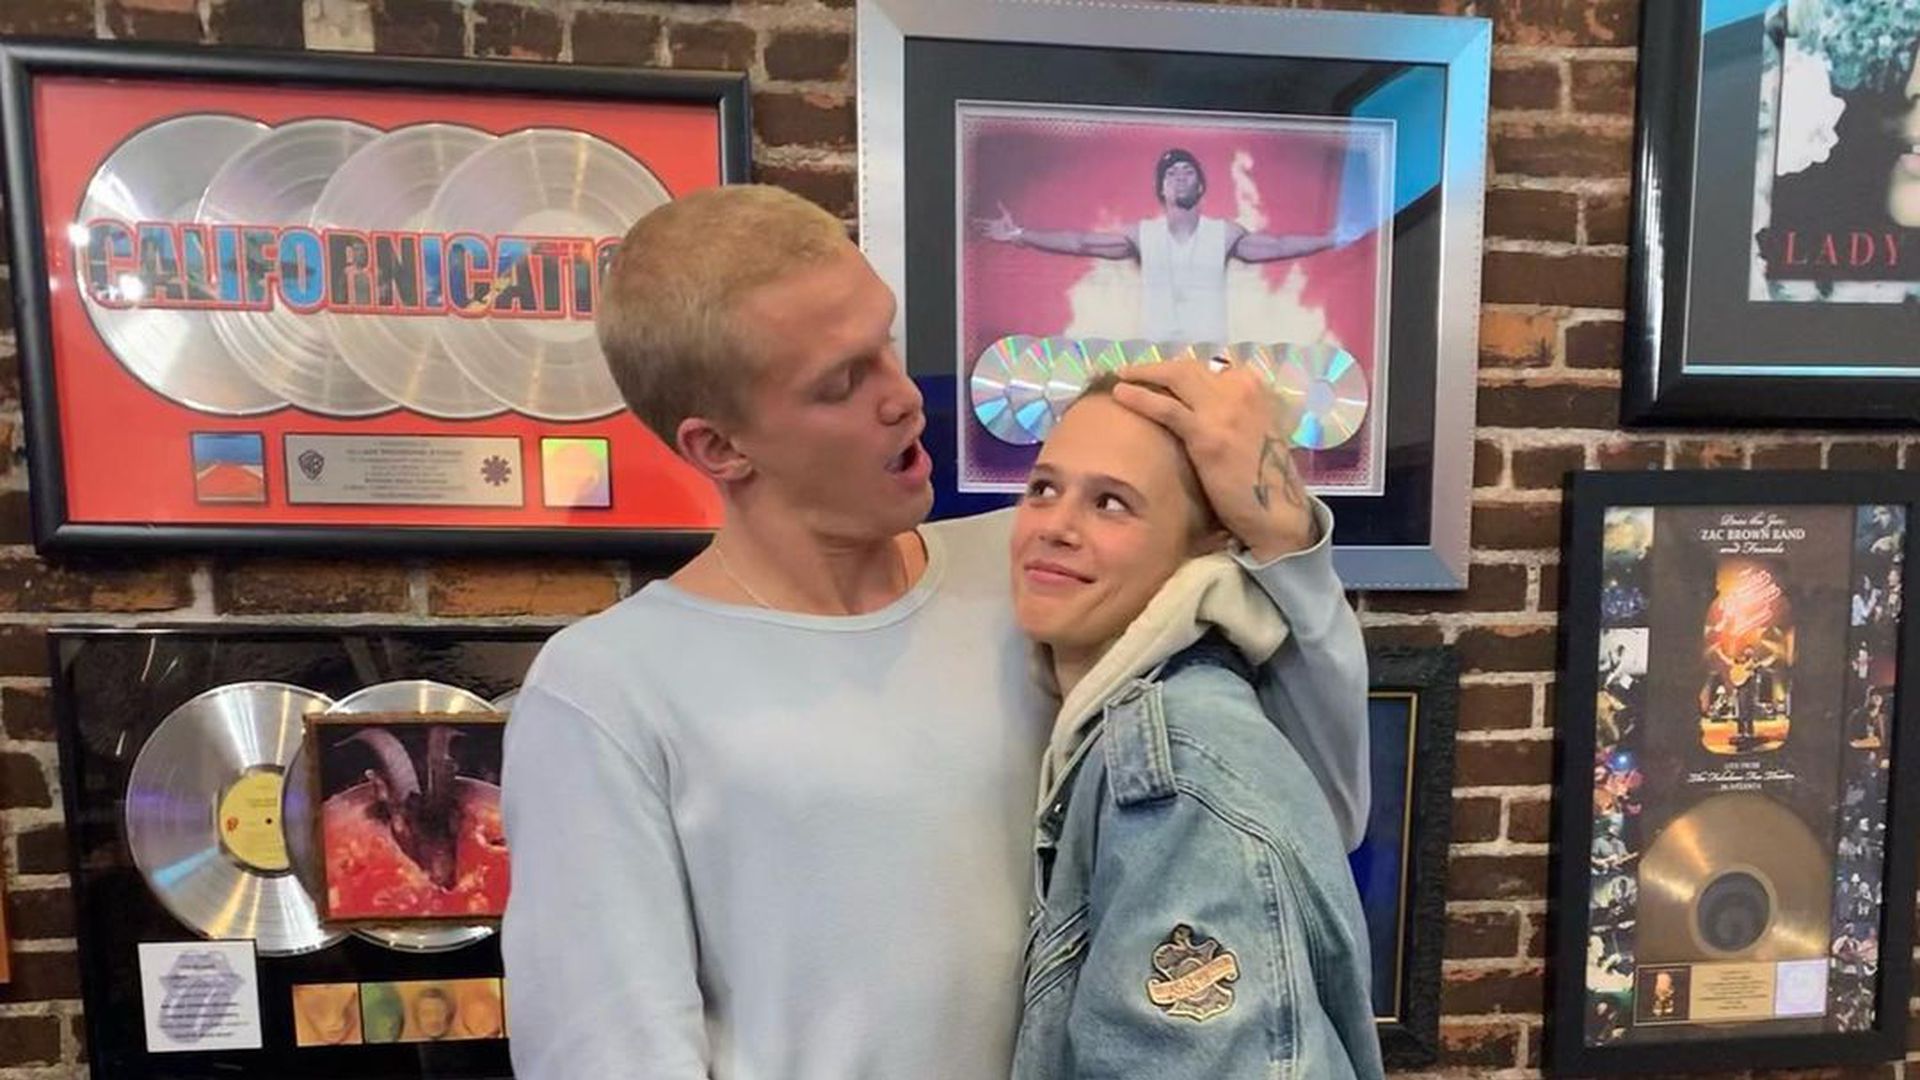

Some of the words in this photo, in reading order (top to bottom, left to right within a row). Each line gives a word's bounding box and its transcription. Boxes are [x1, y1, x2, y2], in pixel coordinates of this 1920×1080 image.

[1783, 230, 1902, 267] LADY
[81, 218, 625, 320] CALIFORNICATI
[1700, 528, 1725, 541] ZAC
[1727, 527, 1770, 541] BROWN
[1772, 527, 1806, 540] BAND
